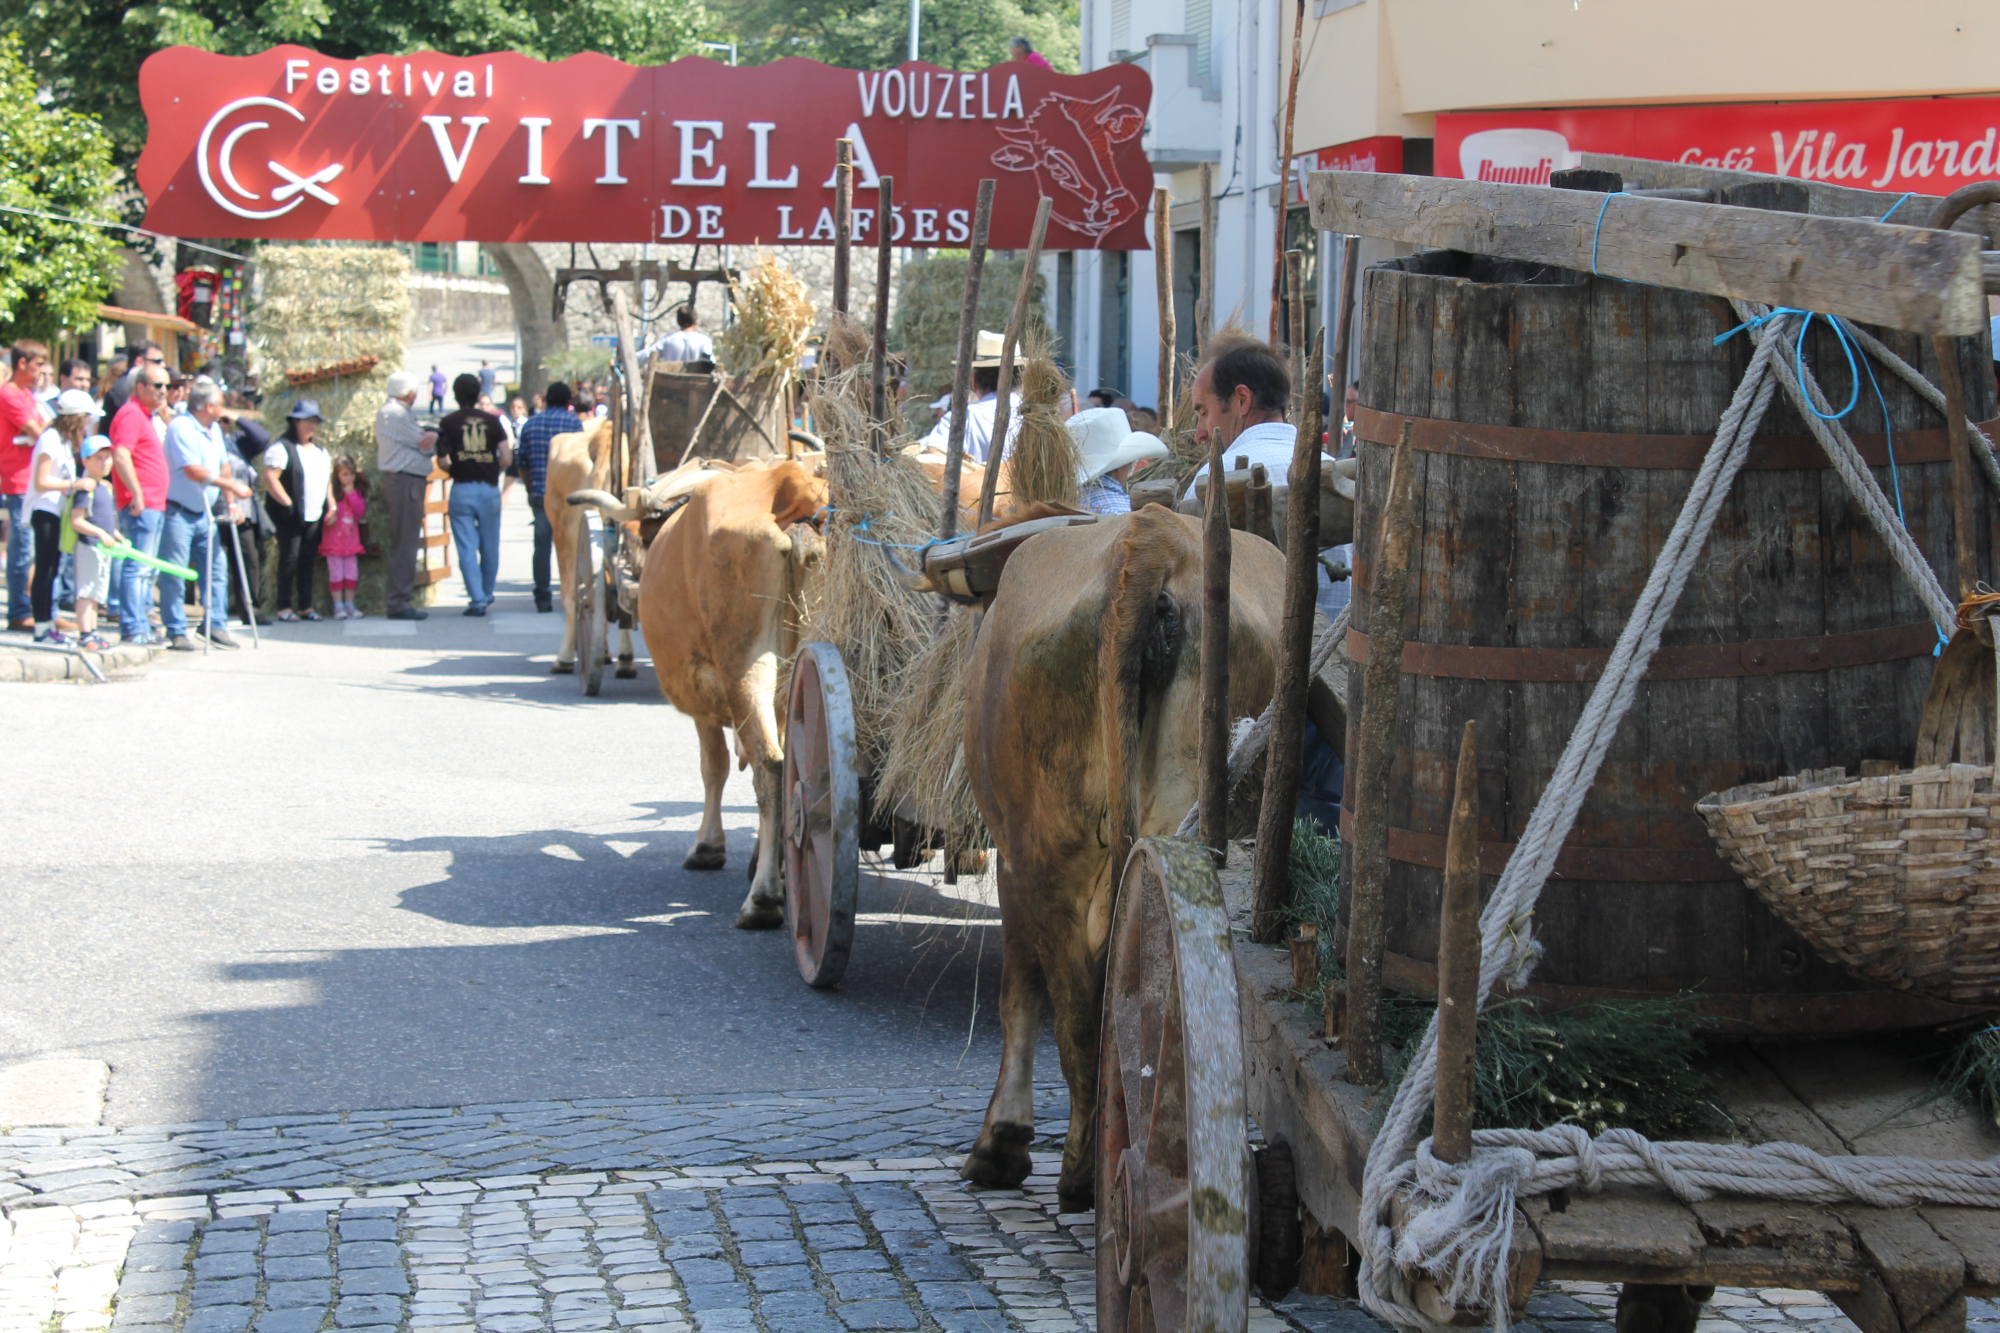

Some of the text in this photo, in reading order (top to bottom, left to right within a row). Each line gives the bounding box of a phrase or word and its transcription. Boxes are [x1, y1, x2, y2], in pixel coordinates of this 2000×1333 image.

[286, 59, 494, 98] Festival
[858, 69, 1024, 120] VOUZELA
[421, 114, 881, 189] VITELA
[1478, 158, 1552, 185] Buondi
[1770, 129, 1868, 180] Vila
[1871, 126, 2000, 189] Jard
[660, 205, 725, 239] DE
